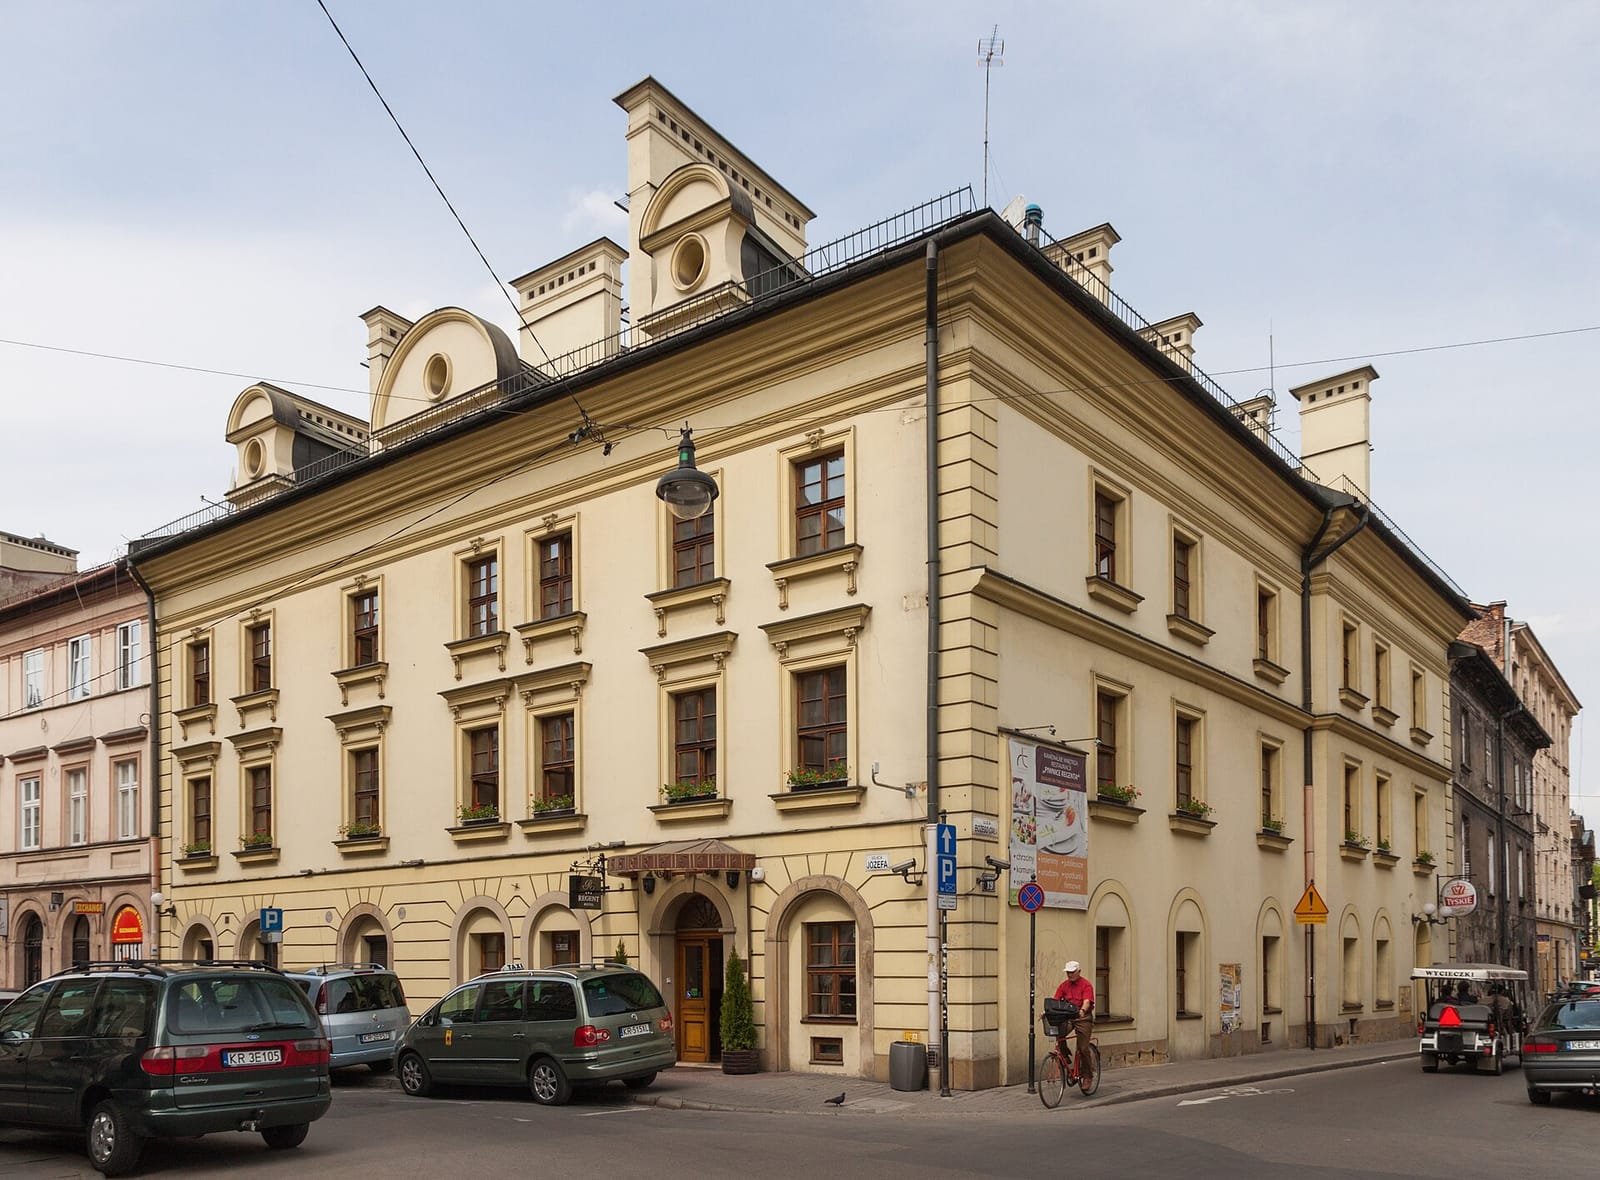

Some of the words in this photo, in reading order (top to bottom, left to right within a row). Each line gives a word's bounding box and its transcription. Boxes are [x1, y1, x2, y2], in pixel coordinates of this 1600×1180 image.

[942, 859, 953, 882] P
[75, 903, 103, 912] EXCHANGE
[1446, 896, 1473, 905] TYSKIE
[266, 911, 278, 928] P
[229, 1053, 245, 1064] KR
[250, 1050, 280, 1063] 3E105
